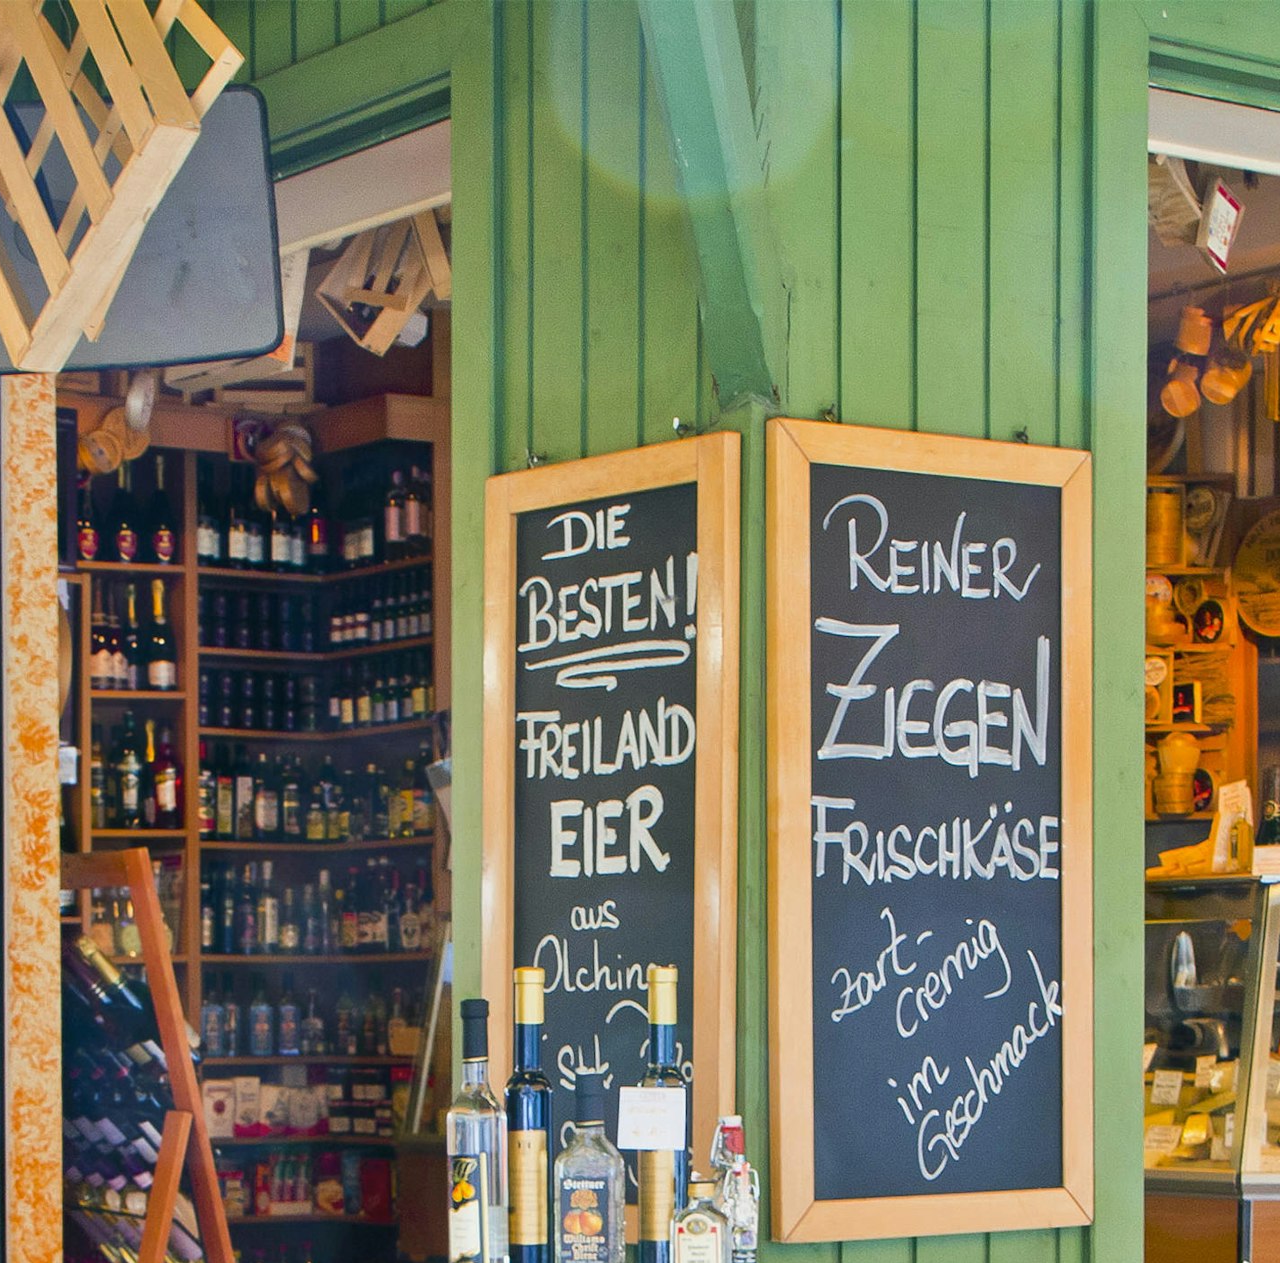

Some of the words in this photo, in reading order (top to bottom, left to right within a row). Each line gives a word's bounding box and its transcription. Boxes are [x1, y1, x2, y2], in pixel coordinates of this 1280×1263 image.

[541, 502, 631, 561] DIE
[822, 493, 1041, 602] REINER
[517, 551, 699, 653] BESTEN!
[516, 696, 696, 780] FREILAND
[814, 616, 1051, 779] ZIEGEN
[549, 784, 671, 878] EIER
[811, 794, 1060, 887] FRISCHKÄSE
[571, 899, 620, 931] aus
[887, 1055, 950, 1125] im
[917, 948, 1064, 1181] Geschmack
